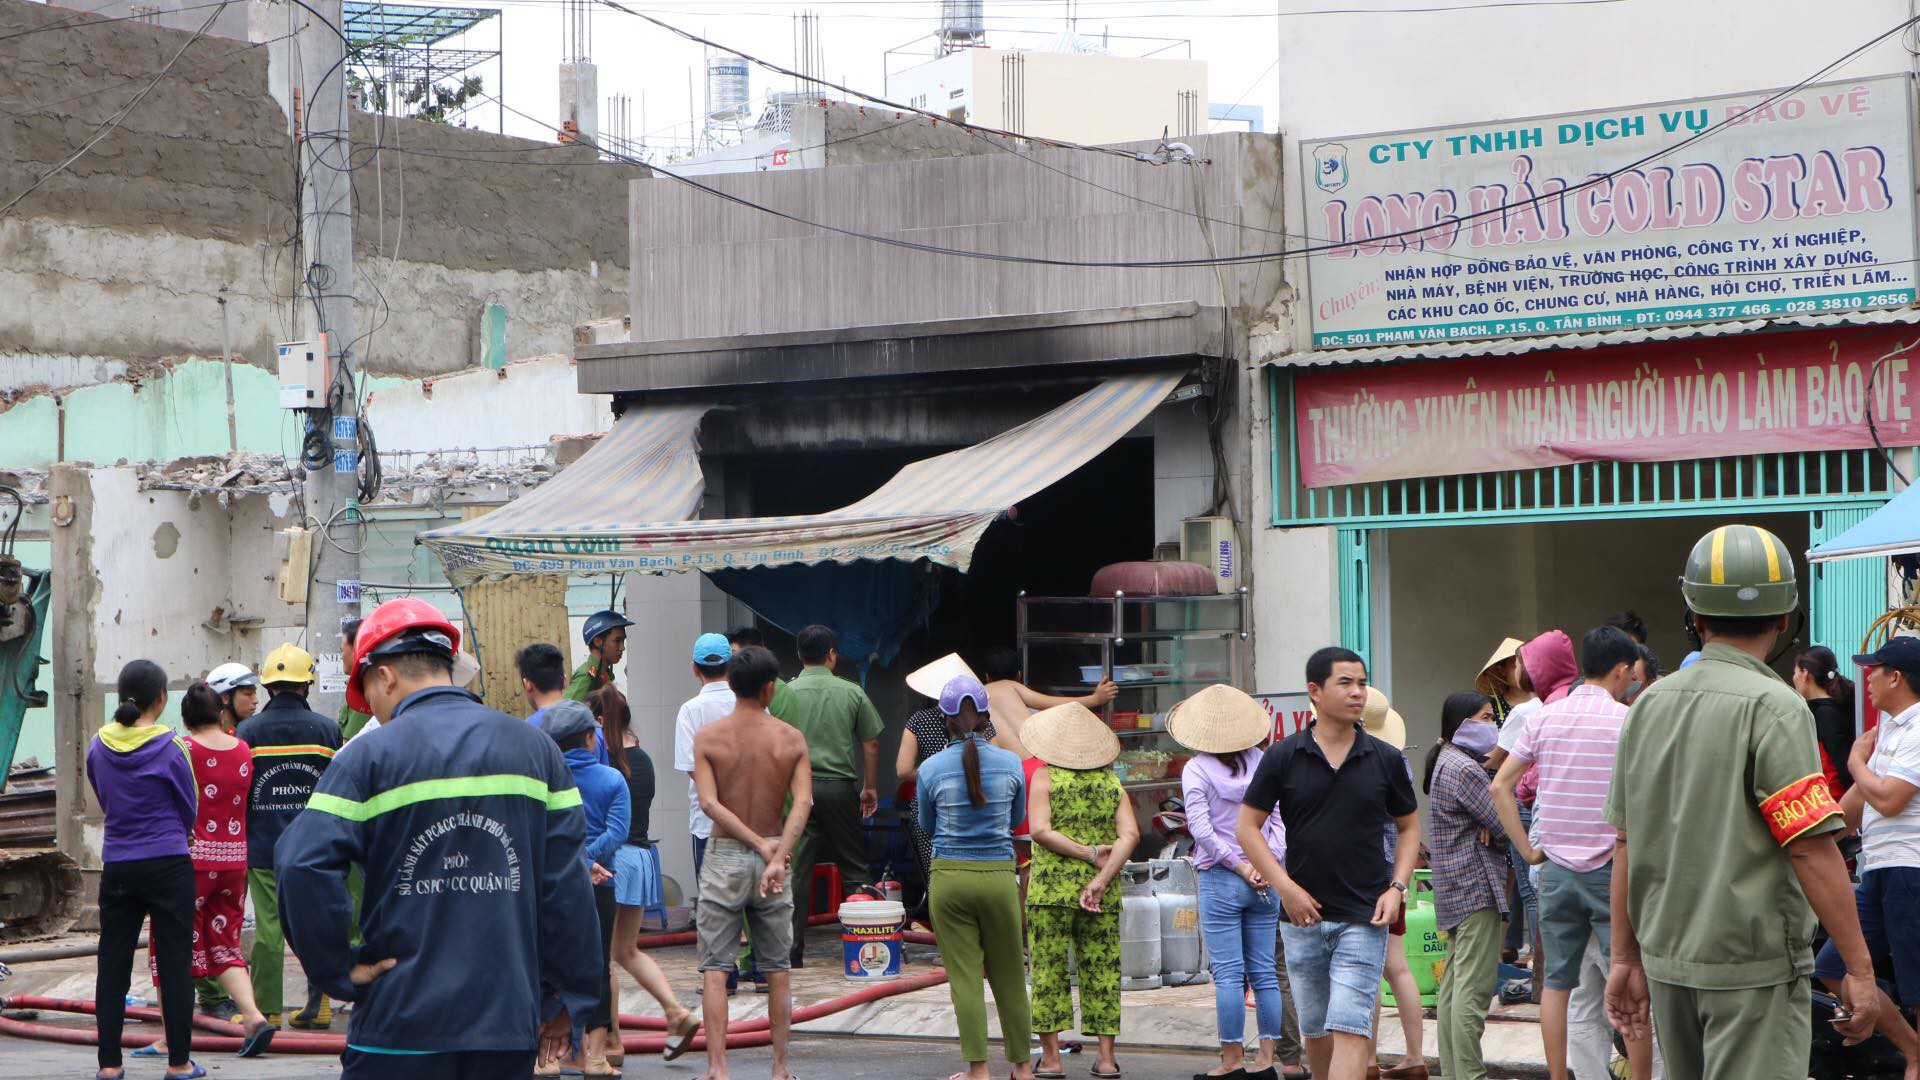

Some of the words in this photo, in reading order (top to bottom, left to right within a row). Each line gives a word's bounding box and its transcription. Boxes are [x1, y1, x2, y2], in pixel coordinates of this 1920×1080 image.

[1368, 139, 1433, 164] CTY
[1446, 127, 1543, 156] TNHH
[1558, 115, 1645, 147] DỊCH
[1659, 108, 1709, 134] VỤ
[1725, 94, 1806, 126] BẢO
[1819, 86, 1872, 117] VỆ
[1322, 189, 1461, 260] LONG
[1467, 154, 1569, 247] HẢI
[1575, 163, 1725, 237] GOLD
[1731, 146, 1893, 223] STAR
[1384, 266, 1426, 283] NHẬN
[1431, 263, 1463, 280] HỢP
[1515, 254, 1547, 271] BẢO
[1552, 251, 1578, 268] VỆ,
[1583, 250, 1616, 266] VĂN
[1621, 244, 1682, 262] PHÒNG,
[1687, 239, 1734, 255] CÔNG
[1738, 238, 1766, 251] TY,
[1772, 232, 1789, 249] XÍ
[1795, 227, 1867, 248] NGHIỆP,
[1386, 285, 1418, 302] NHÀ
[1422, 283, 1460, 300] MÁY,
[1465, 279, 1508, 296] BỆNH
[1512, 275, 1555, 292] VIỆN,
[1630, 267, 1669, 283] HỌC,
[1673, 261, 1720, 278] CÔNG
[1725, 257, 1777, 274] TRÌNH
[1783, 253, 1818, 270] XÂY
[1824, 249, 1879, 268] DỰNG,
[1319, 278, 1381, 321] Chuyên:
[1321, 335, 1343, 346] ĐC:
[1347, 333, 1372, 345] 501
[1418, 326, 1446, 339] VĂN
[1535, 320, 1550, 333] Q.
[1554, 315, 1583, 330] TÂN
[1586, 313, 1622, 328] BÌNH
[1636, 311, 1661, 325] ĐT:
[1665, 308, 1704, 322] 0944
[1708, 306, 1737, 319] 377
[1742, 303, 1771, 316] 466
[1786, 299, 1816, 313] 028
[1822, 296, 1863, 310] 3810
[1867, 293, 1909, 306] 2656
[1387, 305, 1417, 321] CÁC
[1422, 304, 1454, 320] KHU
[1458, 302, 1489, 317] CAO
[1493, 297, 1520, 313] ỐC,
[1524, 294, 1579, 312] CHUNG
[1583, 290, 1611, 306] CƯ,
[1615, 288, 1649, 304] NHÀ
[1655, 285, 1705, 302] HÀNG,
[1711, 280, 1740, 298] HỘI
[1745, 276, 1787, 294] CHỢ,
[1308, 387, 1408, 464] THƯỜNG
[1415, 376, 1499, 451] XUYÊN
[1585, 361, 1665, 441] NGƯỜI
[1674, 357, 1729, 435] VÀO
[1738, 352, 1797, 431] LÀM
[1807, 340, 1864, 427] BẢO
[1872, 341, 1913, 434] VỆ
[539, 559, 565, 570] 499
[271, 783, 311, 796] PHÒNG
[424, 816, 457, 842] PC&CC
[1772, 800, 1807, 830] BẢO
[469, 871, 503, 894] QUẬN
[852, 926, 896, 935] MAXILITE
